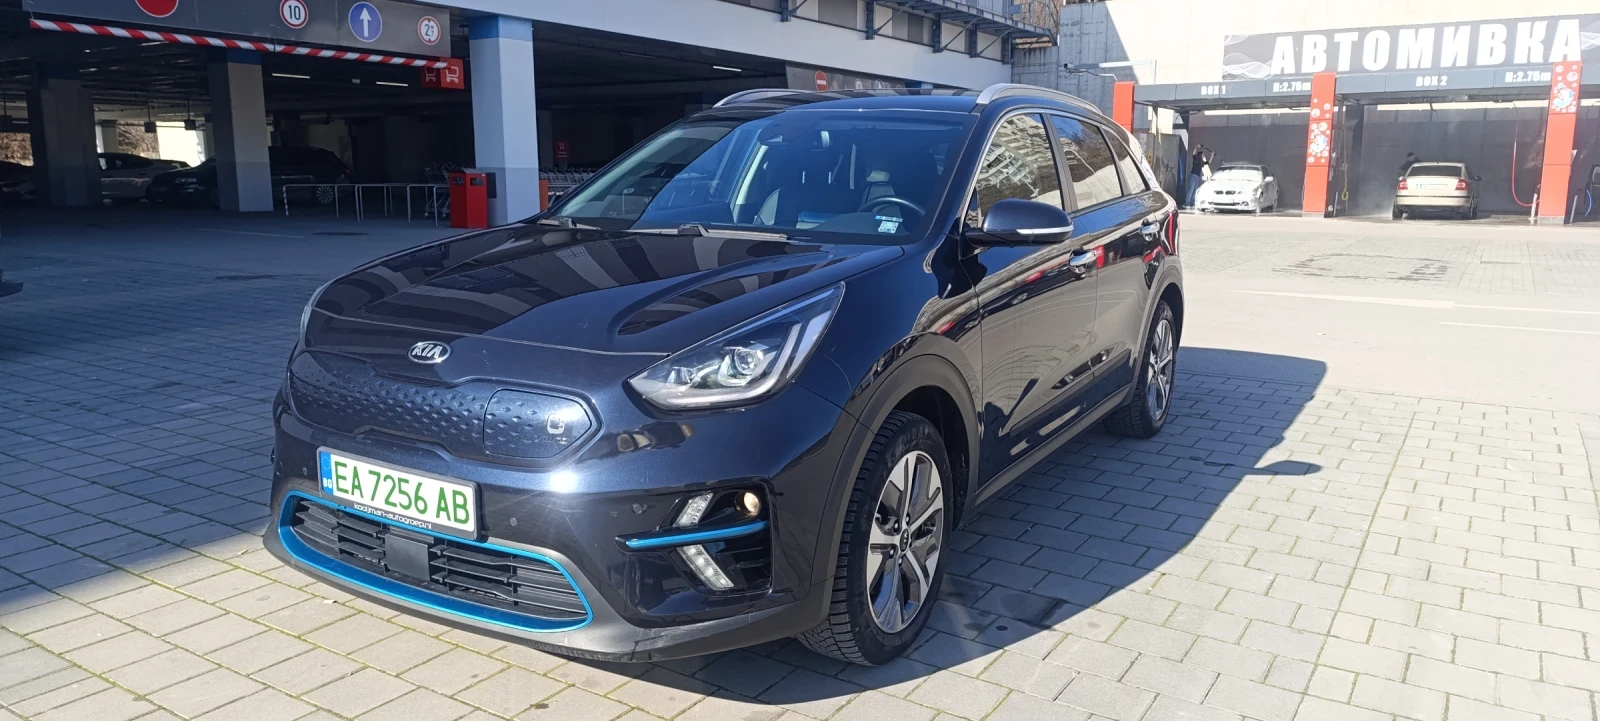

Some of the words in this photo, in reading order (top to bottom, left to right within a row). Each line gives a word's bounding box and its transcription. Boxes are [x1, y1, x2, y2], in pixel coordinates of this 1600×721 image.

[288, 5, 301, 20] 10
[1270, 19, 1582, 75] АВТОМИВКА
[1416, 76, 1438, 87] BOX
[1439, 75, 1448, 86] 2
[1201, 85, 1220, 95] BOX
[1221, 85, 1226, 95] 1
[411, 343, 443, 359] KIA
[323, 477, 333, 489] BG
[334, 460, 364, 499] EA
[368, 469, 428, 515] 7256
[435, 486, 470, 525] AB
